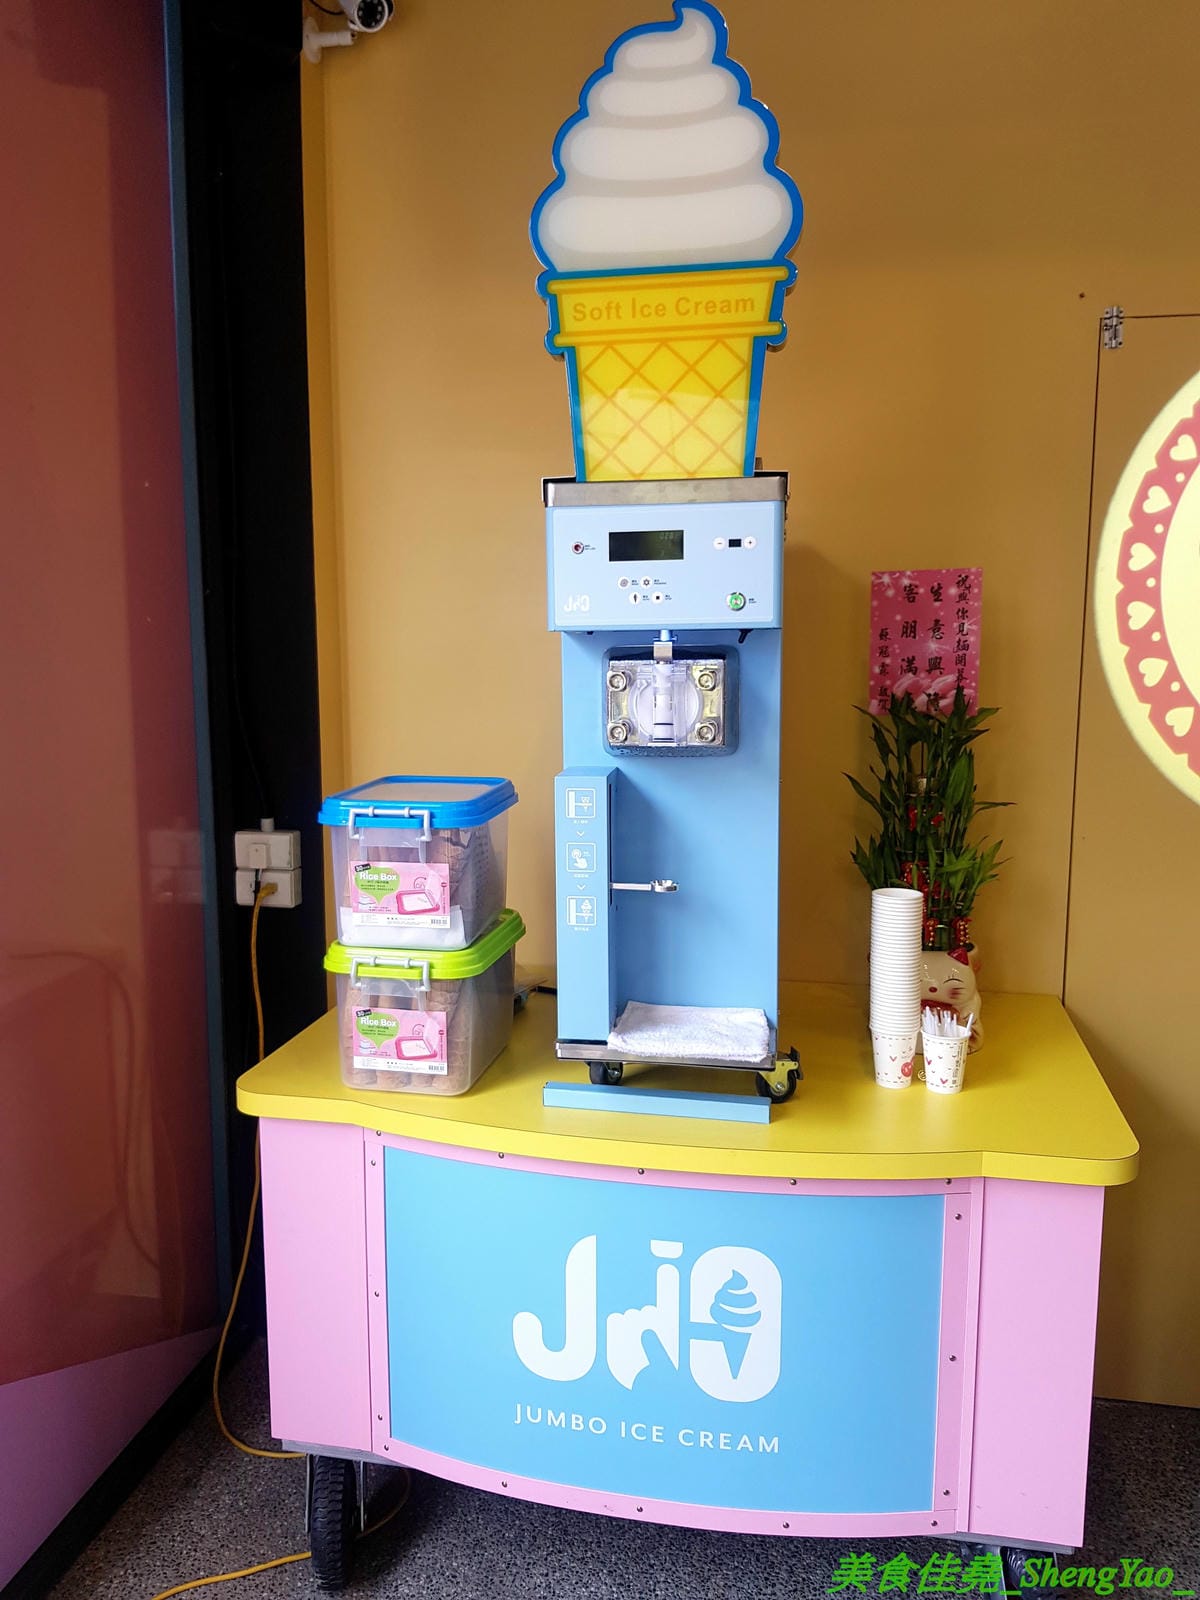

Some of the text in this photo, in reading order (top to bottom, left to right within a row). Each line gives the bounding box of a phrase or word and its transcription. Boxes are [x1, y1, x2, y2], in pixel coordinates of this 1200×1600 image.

[572, 296, 755, 322] Soft Ice Cream
[359, 869, 397, 881] Rice Box
[360, 1016, 379, 1026] Rice
[380, 1018, 397, 1027] Box
[514, 1403, 779, 1453] JUMBO ICE CREAM
